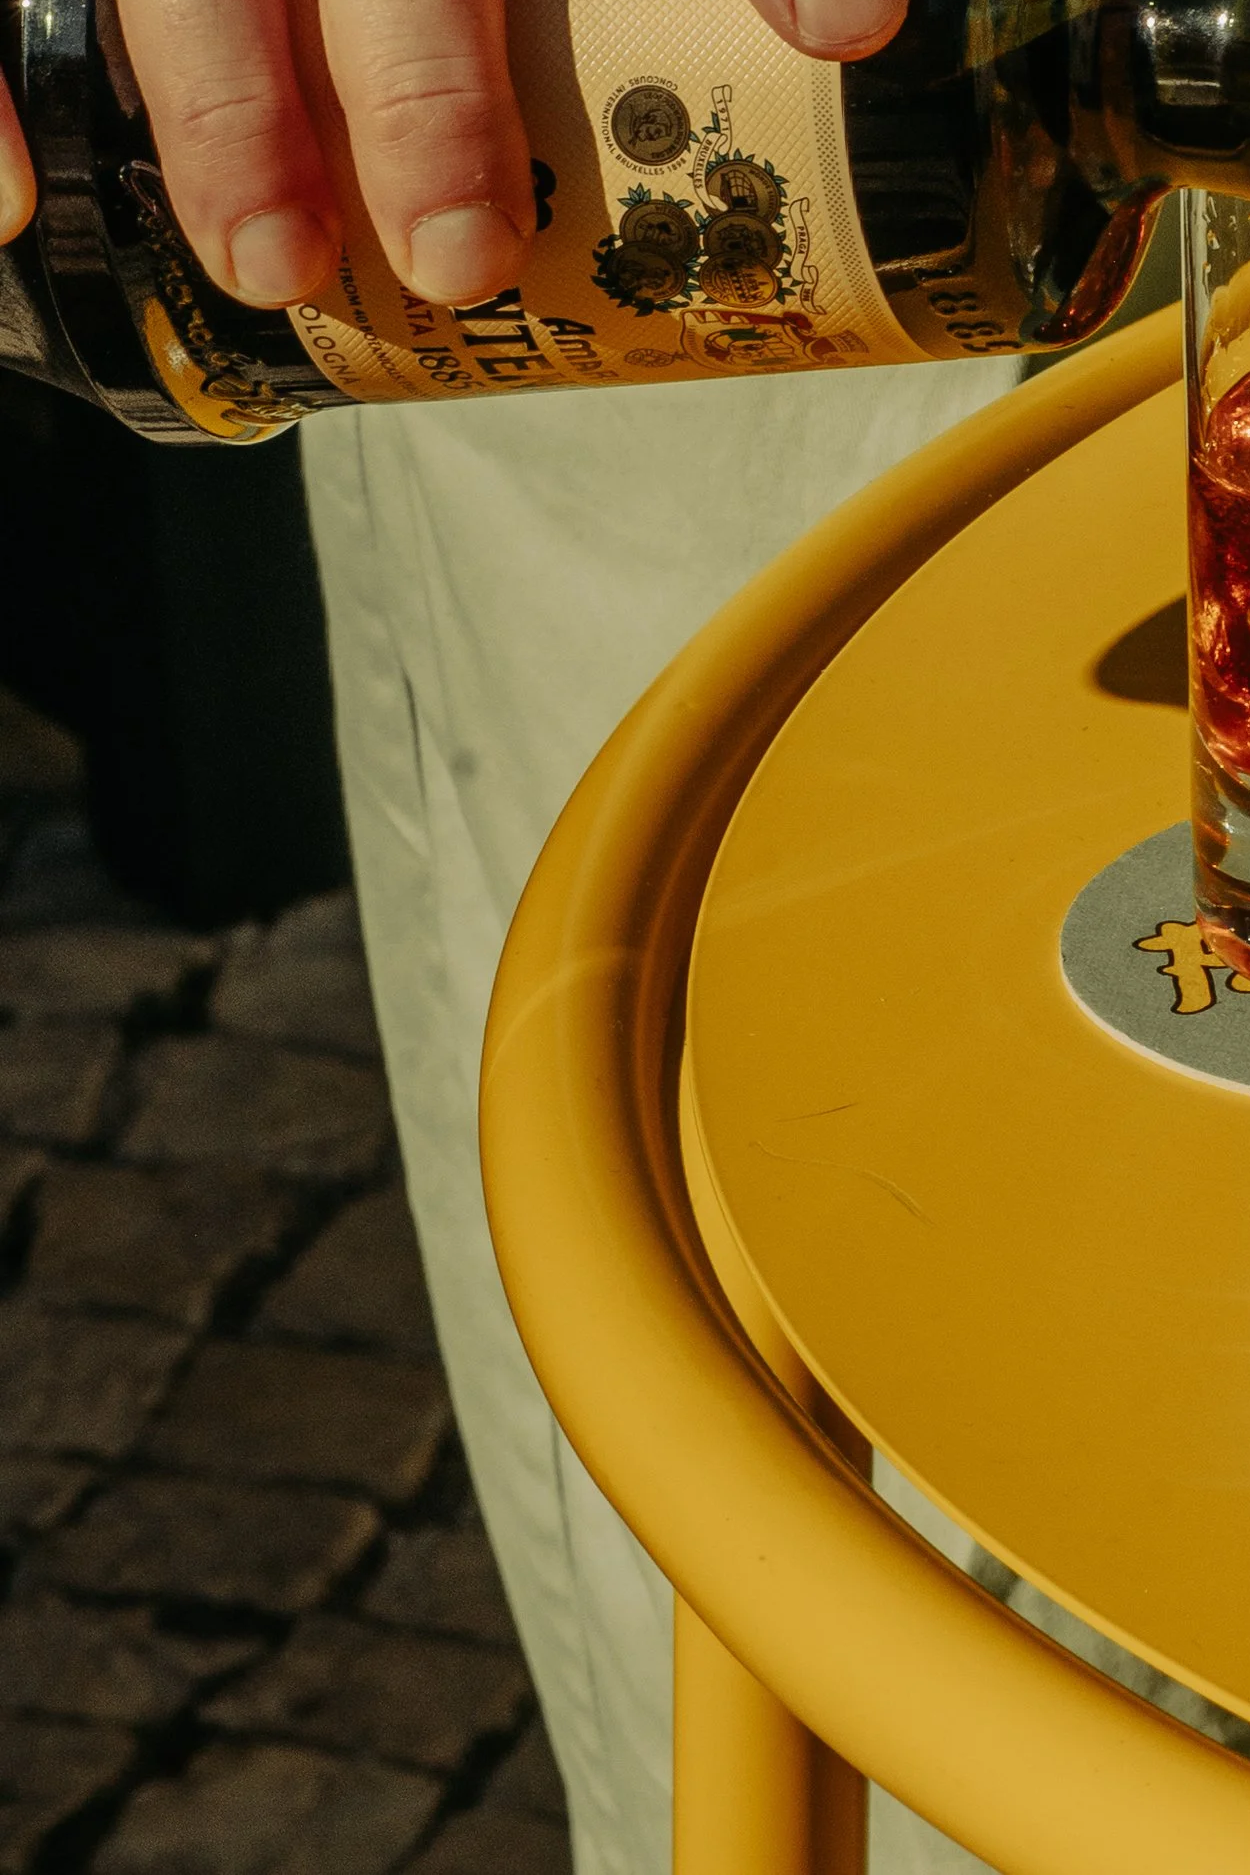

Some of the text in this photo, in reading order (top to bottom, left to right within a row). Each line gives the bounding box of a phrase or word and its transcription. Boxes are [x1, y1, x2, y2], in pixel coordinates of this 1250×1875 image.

[716, 99, 729, 131] 1971
[615, 153, 666, 176] BRUXELLES
[694, 139, 713, 189] BRUXELLES
[299, 303, 361, 387] OLOGNA
